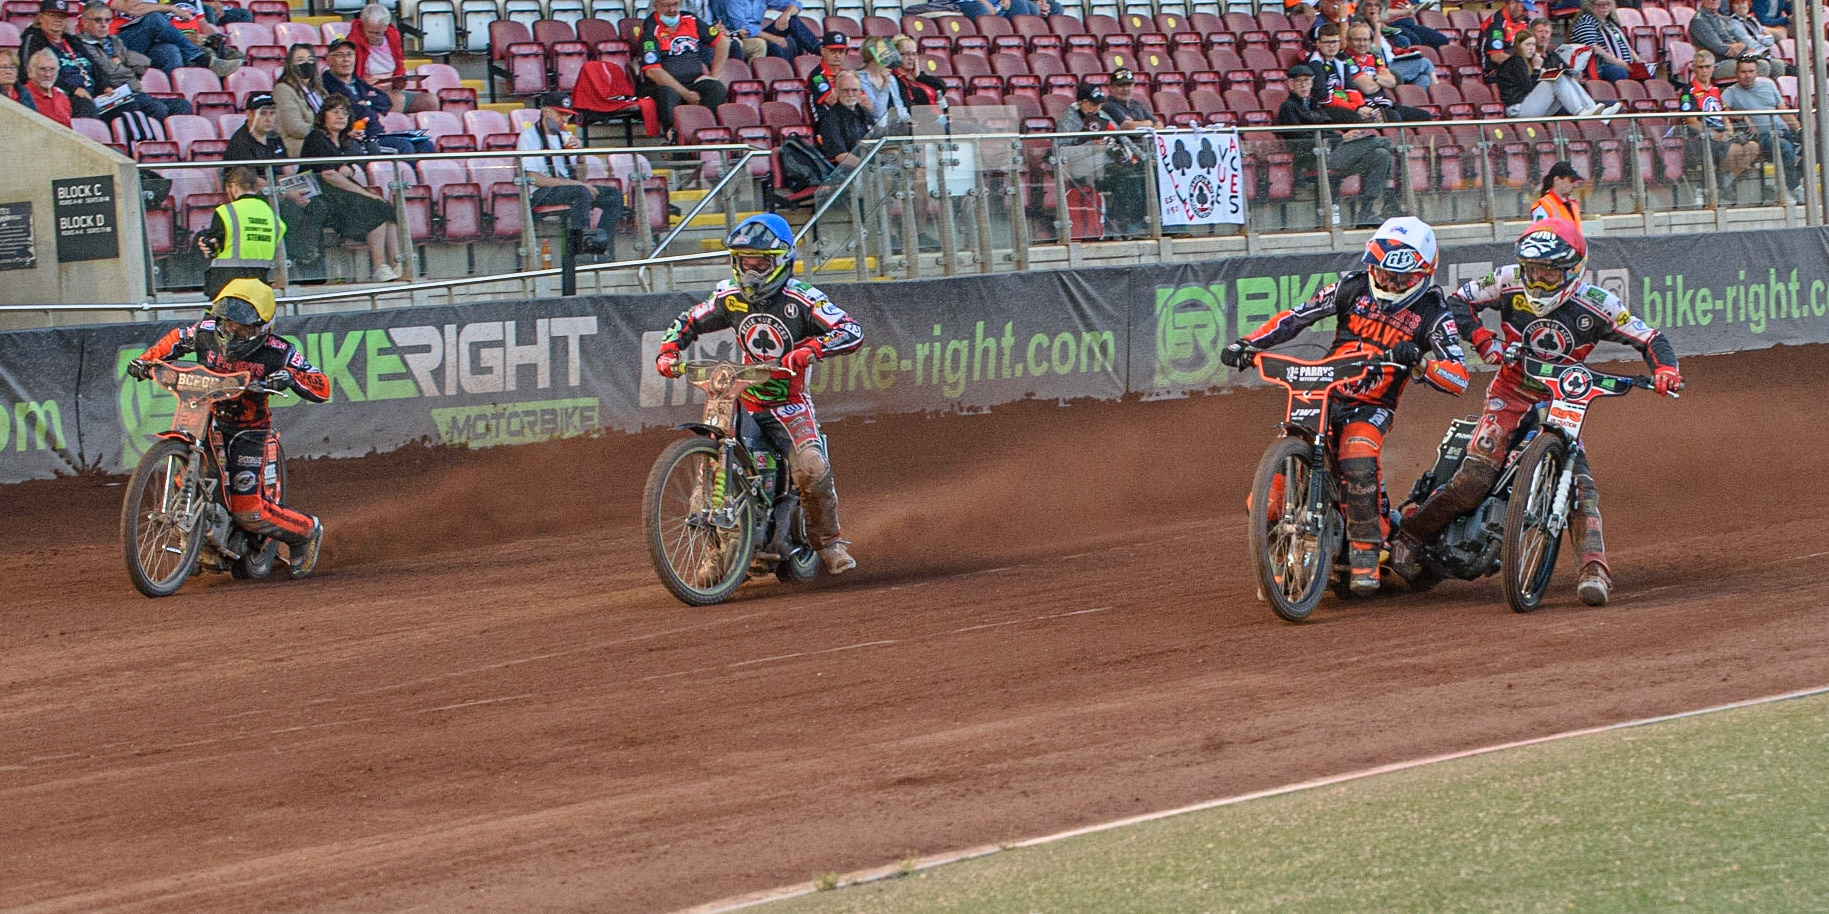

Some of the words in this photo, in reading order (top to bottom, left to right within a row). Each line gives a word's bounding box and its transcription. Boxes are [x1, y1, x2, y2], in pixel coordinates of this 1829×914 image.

[58, 185, 92, 199] BLOCK
[93, 184, 102, 196] C
[60, 215, 94, 229] BLOCK
[96, 214, 105, 227] D
[1643, 268, 1829, 334] bike-right.c
[787, 306, 795, 316] 4
[1299, 366, 1335, 377] PARRYS
[1291, 408, 1321, 417] JWP
[450, 405, 597, 441] MOTORBIKE
